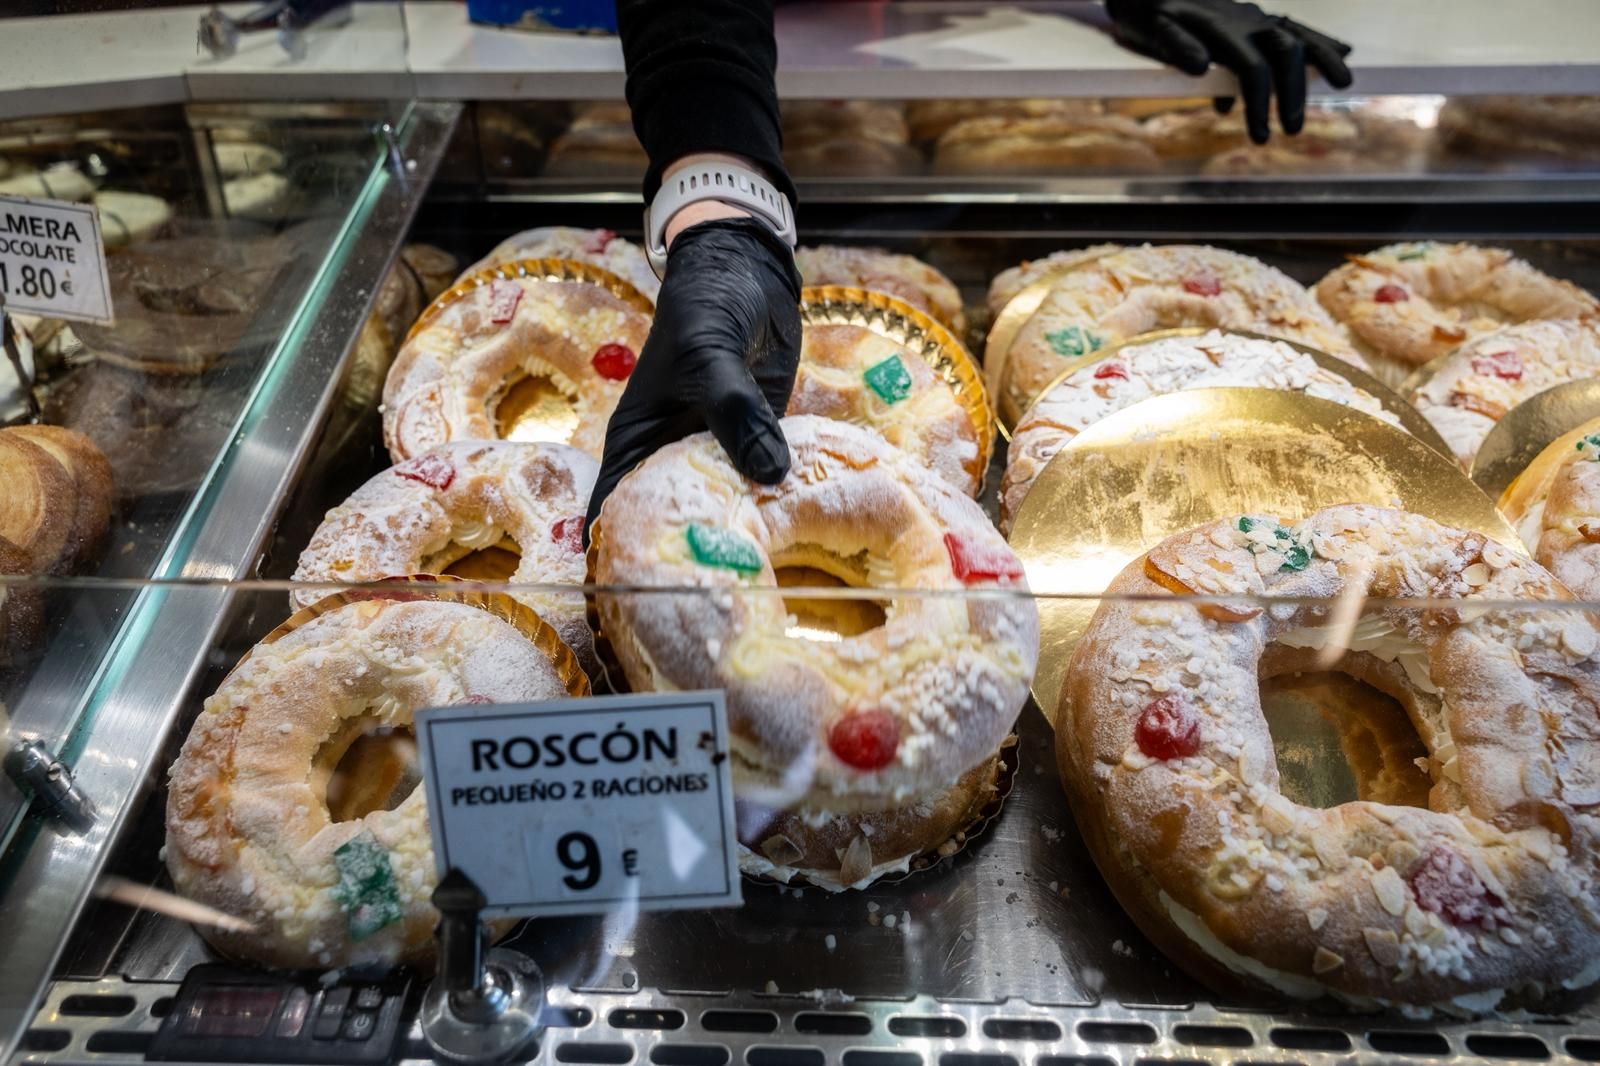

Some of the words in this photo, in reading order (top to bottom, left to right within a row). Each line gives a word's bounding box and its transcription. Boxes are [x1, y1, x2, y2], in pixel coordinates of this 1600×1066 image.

[60, 280, 74, 296] €
[471, 722, 678, 772] ROSCÓN
[452, 778, 565, 806] PEQUEÑO
[572, 780, 586, 799] 2
[592, 773, 709, 798] RACIONES
[556, 831, 602, 891] 9
